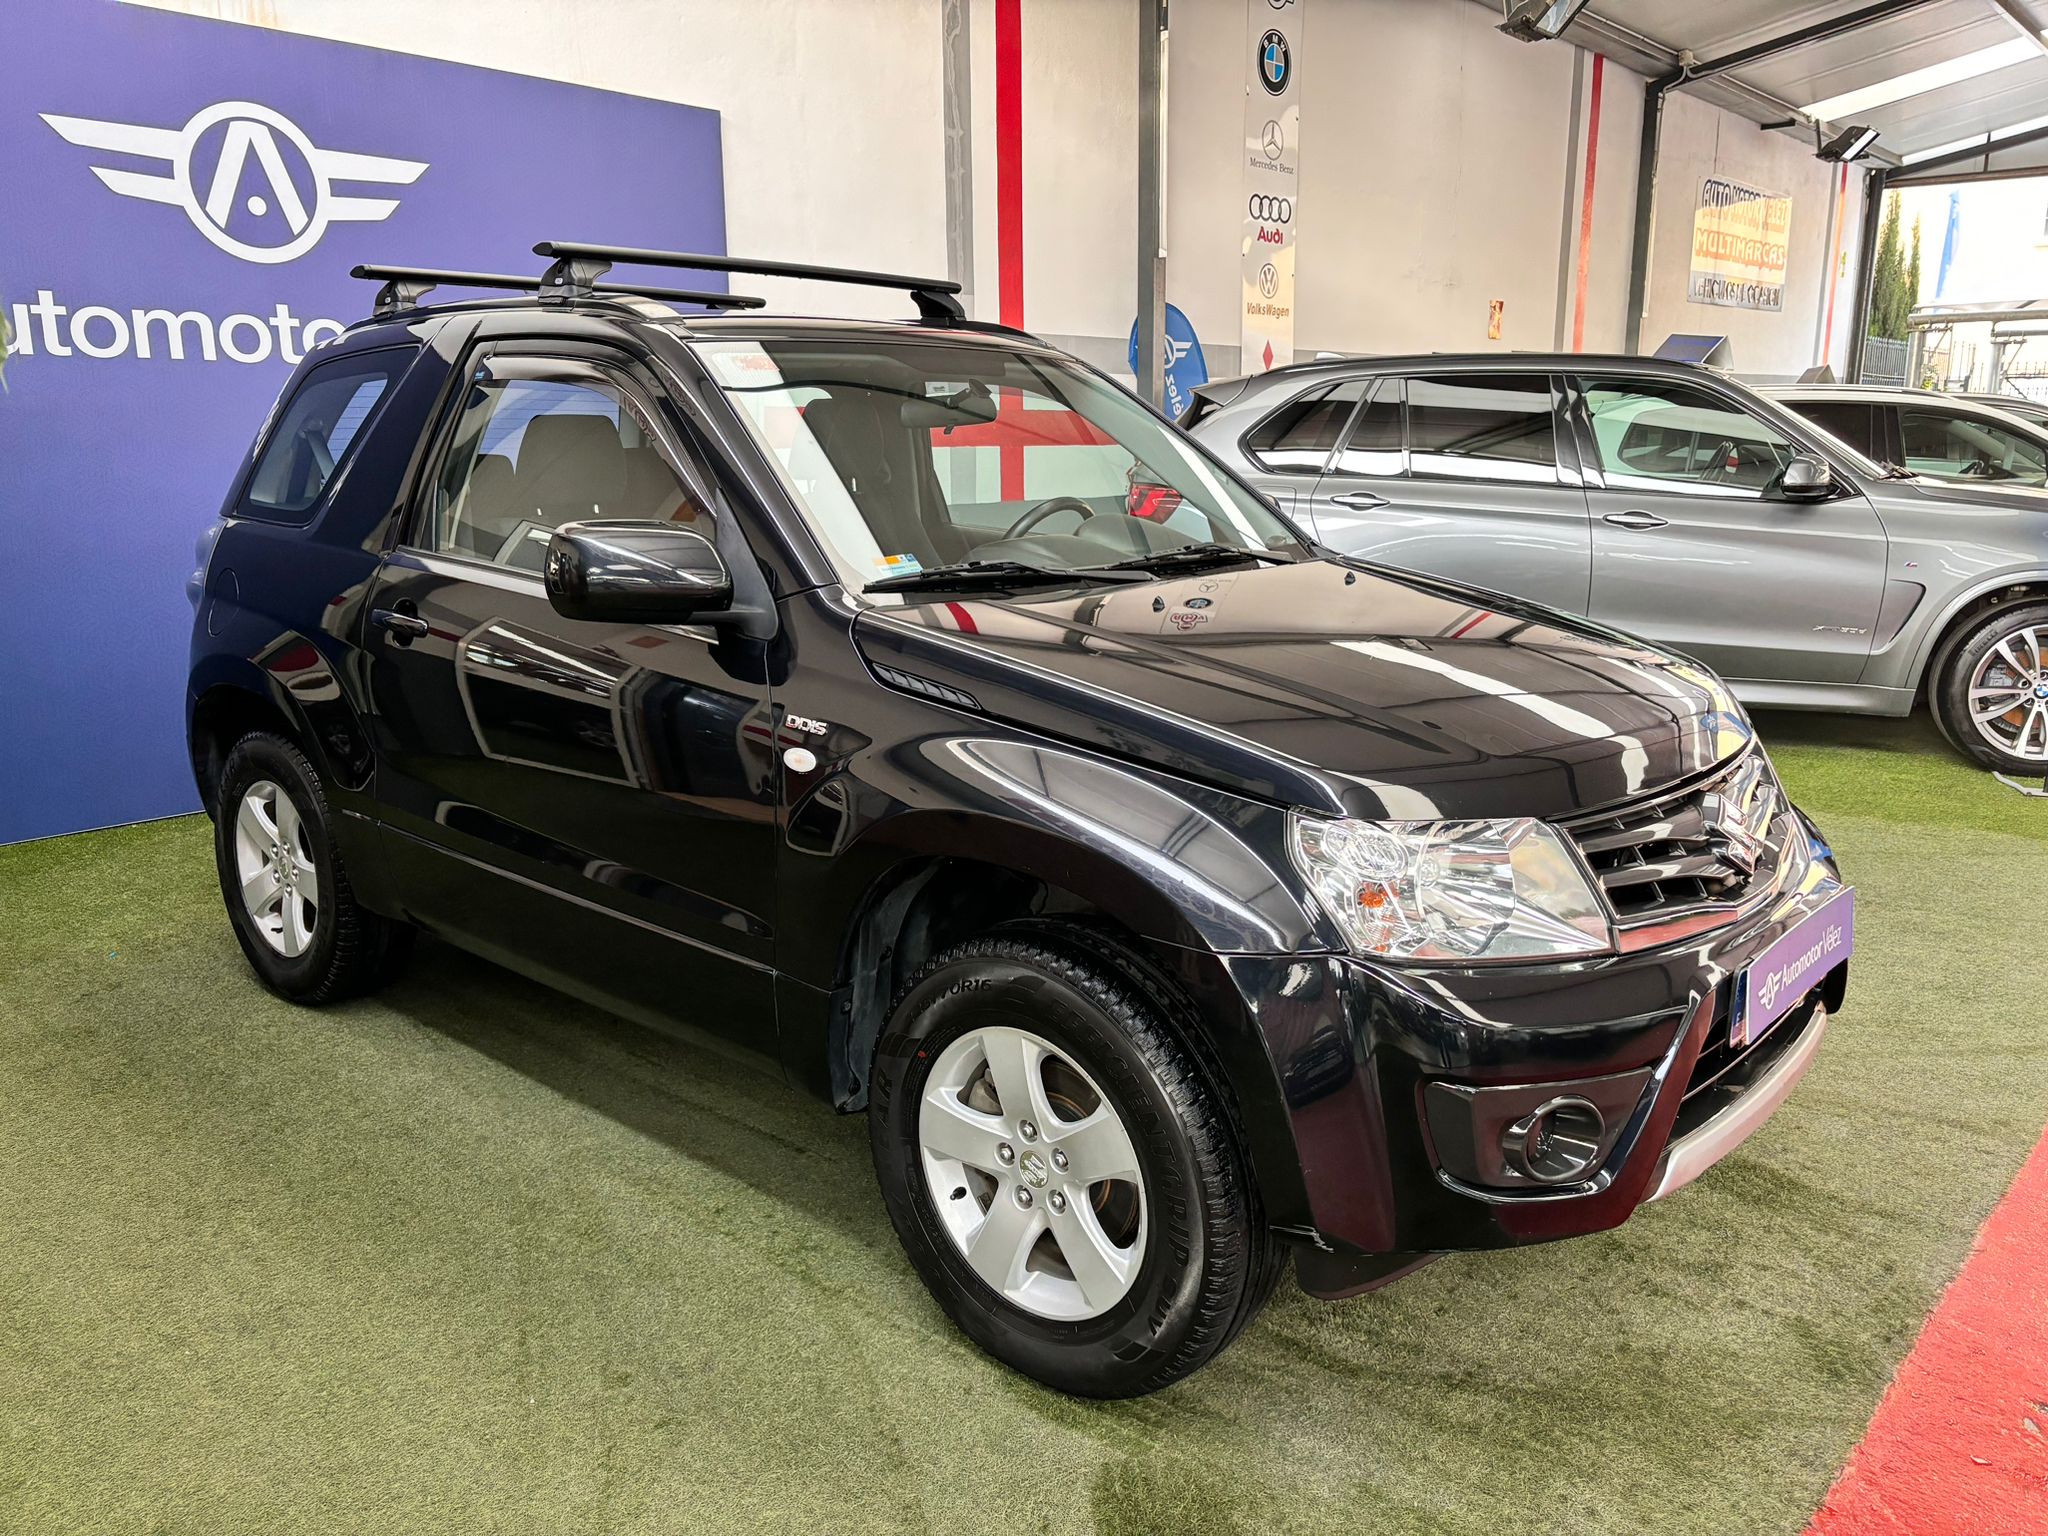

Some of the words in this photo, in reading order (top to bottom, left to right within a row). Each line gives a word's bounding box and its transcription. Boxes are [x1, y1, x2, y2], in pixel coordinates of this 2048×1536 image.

[1262, 34, 1287, 52] BMW
[1249, 156, 1279, 173] Mercedes
[1279, 162, 1295, 175] Benz
[1257, 225, 1284, 245] Audi
[1695, 227, 1786, 267] MULTIMARCAS
[1780, 939, 1823, 991] Automotor
[1822, 924, 1842, 956] Vélez
